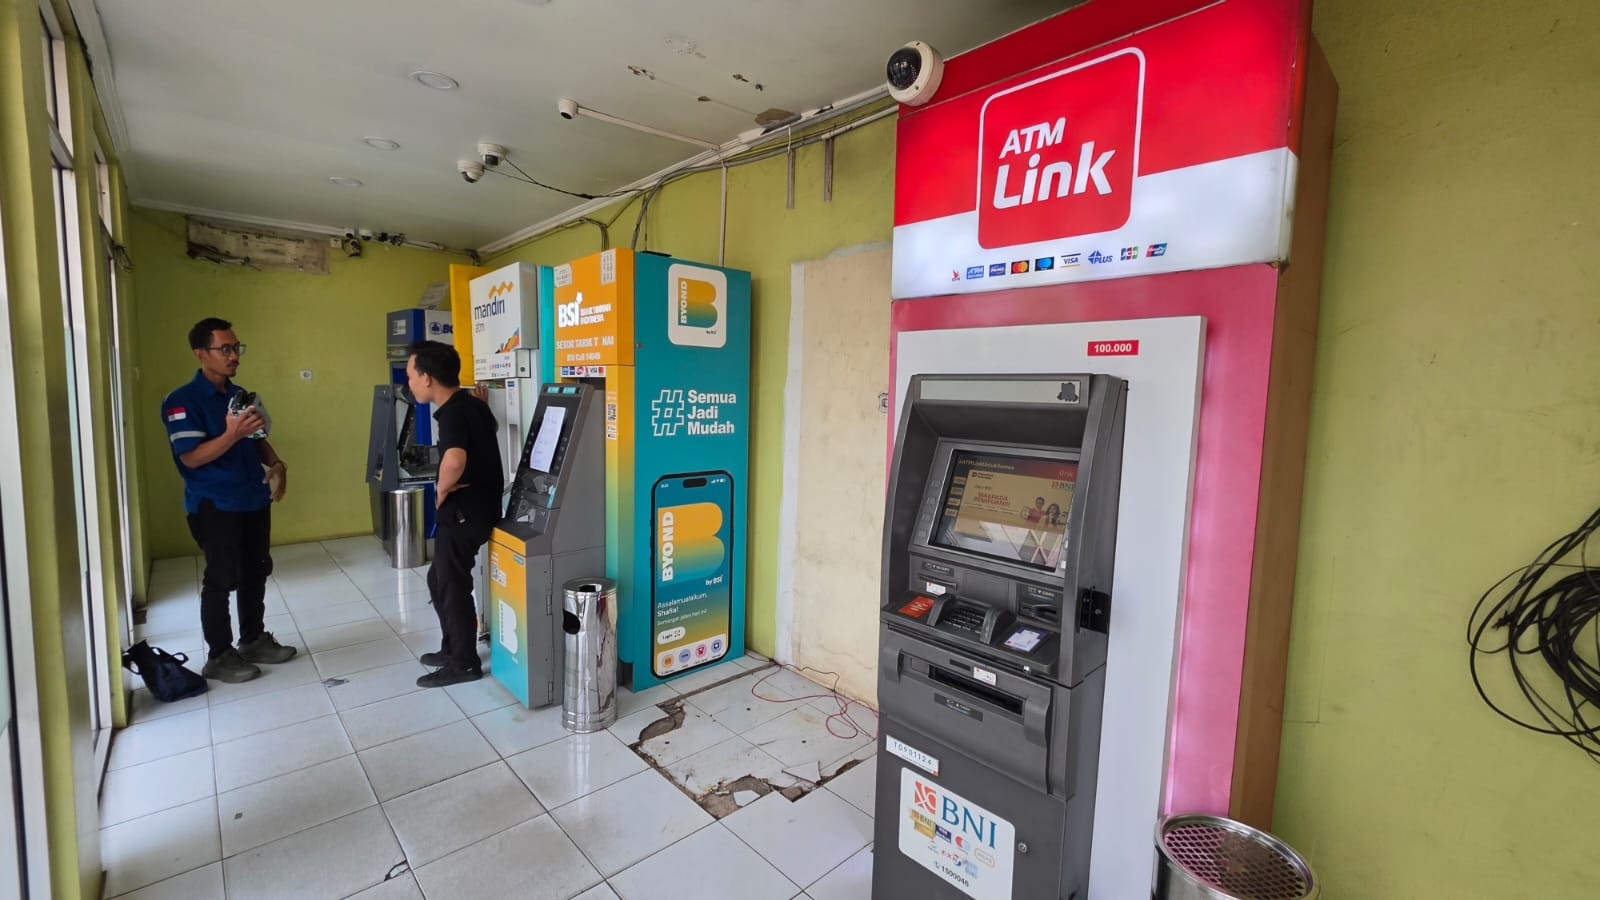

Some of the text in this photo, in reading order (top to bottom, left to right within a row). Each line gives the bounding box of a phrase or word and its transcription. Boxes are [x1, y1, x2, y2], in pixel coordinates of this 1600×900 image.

[998, 117, 1066, 159] ATM
[992, 140, 1117, 210] Link
[1063, 257, 1079, 265] VISA
[1094, 255, 1113, 264] PLUS
[474, 296, 505, 320] mandiri
[558, 301, 580, 328] BSI
[1093, 344, 1132, 353] 100.000
[687, 389, 737, 404] Semua
[687, 406, 718, 420] Jadi
[687, 421, 735, 435] Mudah
[662, 511, 674, 582] BYOND
[705, 578, 713, 586] by
[919, 813, 932, 828] BNI
[942, 795, 997, 849] BNI
